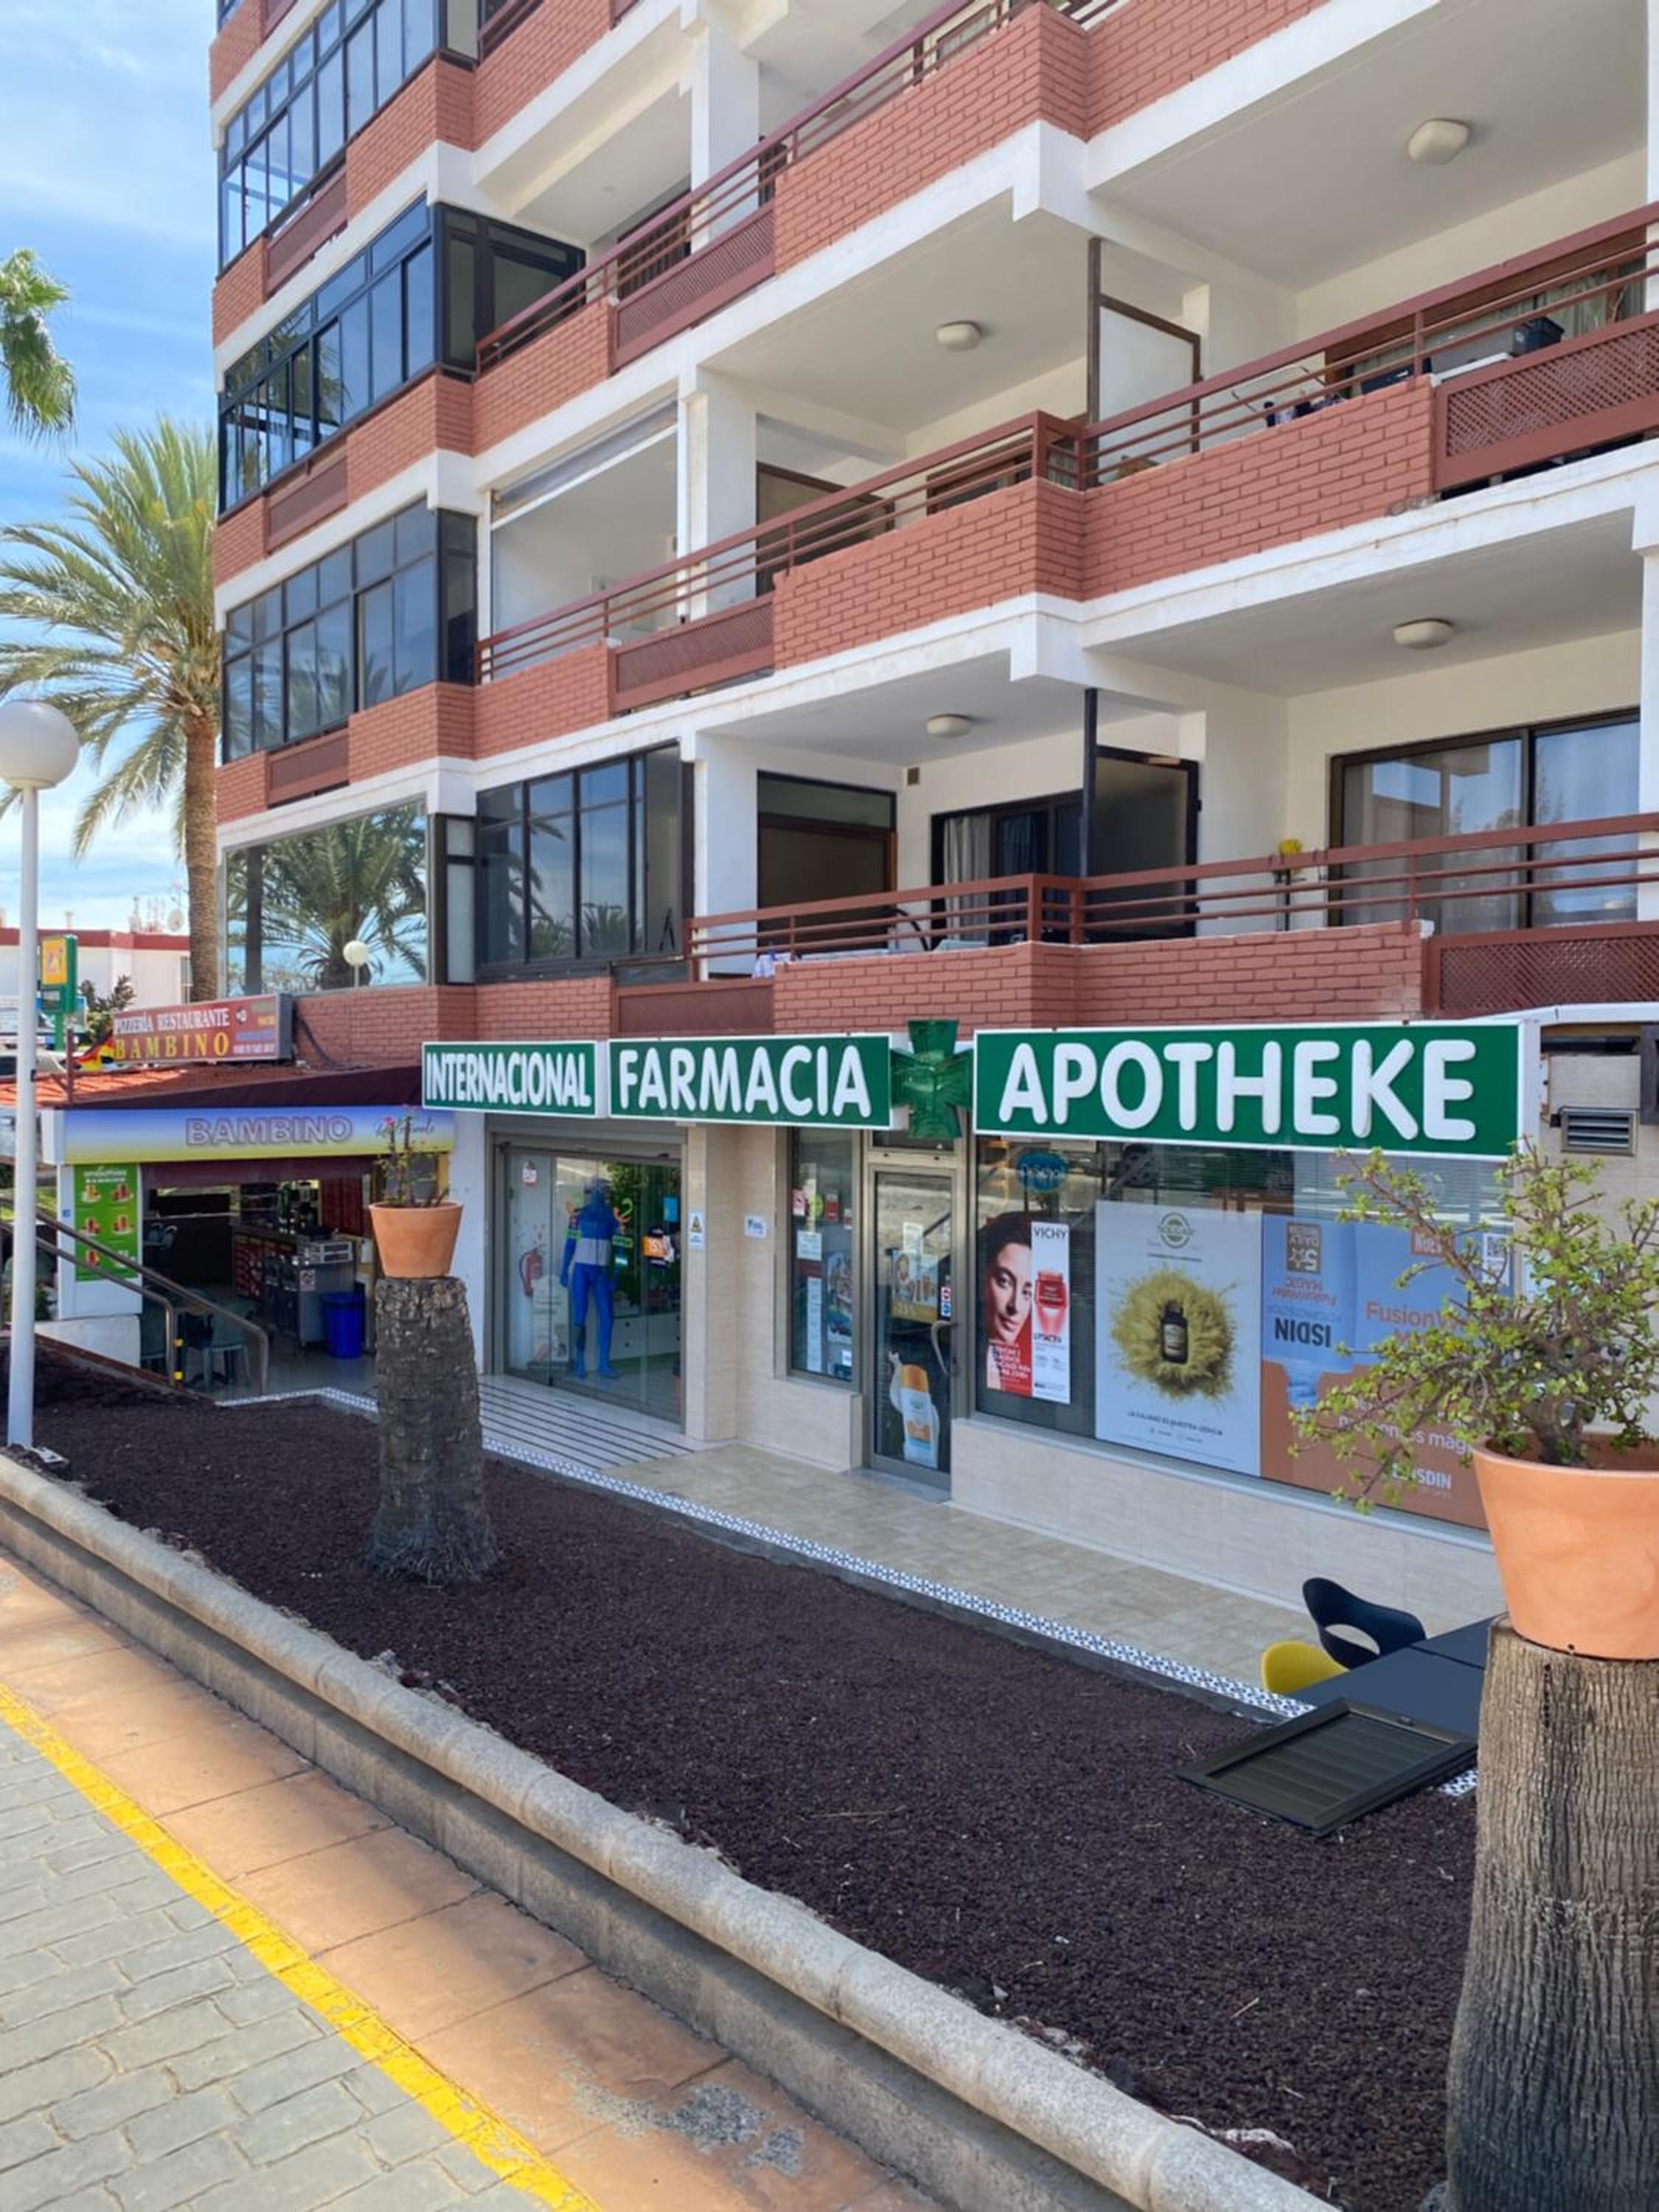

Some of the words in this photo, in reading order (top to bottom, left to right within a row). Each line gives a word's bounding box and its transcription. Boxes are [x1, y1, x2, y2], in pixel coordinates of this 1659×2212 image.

[157, 1008, 229, 1032] RESTAURANTE
[115, 1031, 229, 1060] BAMBINO
[425, 1051, 592, 1107] INTERNACIONAL
[619, 1045, 872, 1119] FARMACIA
[998, 1039, 1476, 1141] APOTHEKE
[185, 1116, 352, 1147] BAMBINO
[1033, 1225, 1067, 1240] VICHY
[1274, 1317, 1332, 1348] ISDIN
